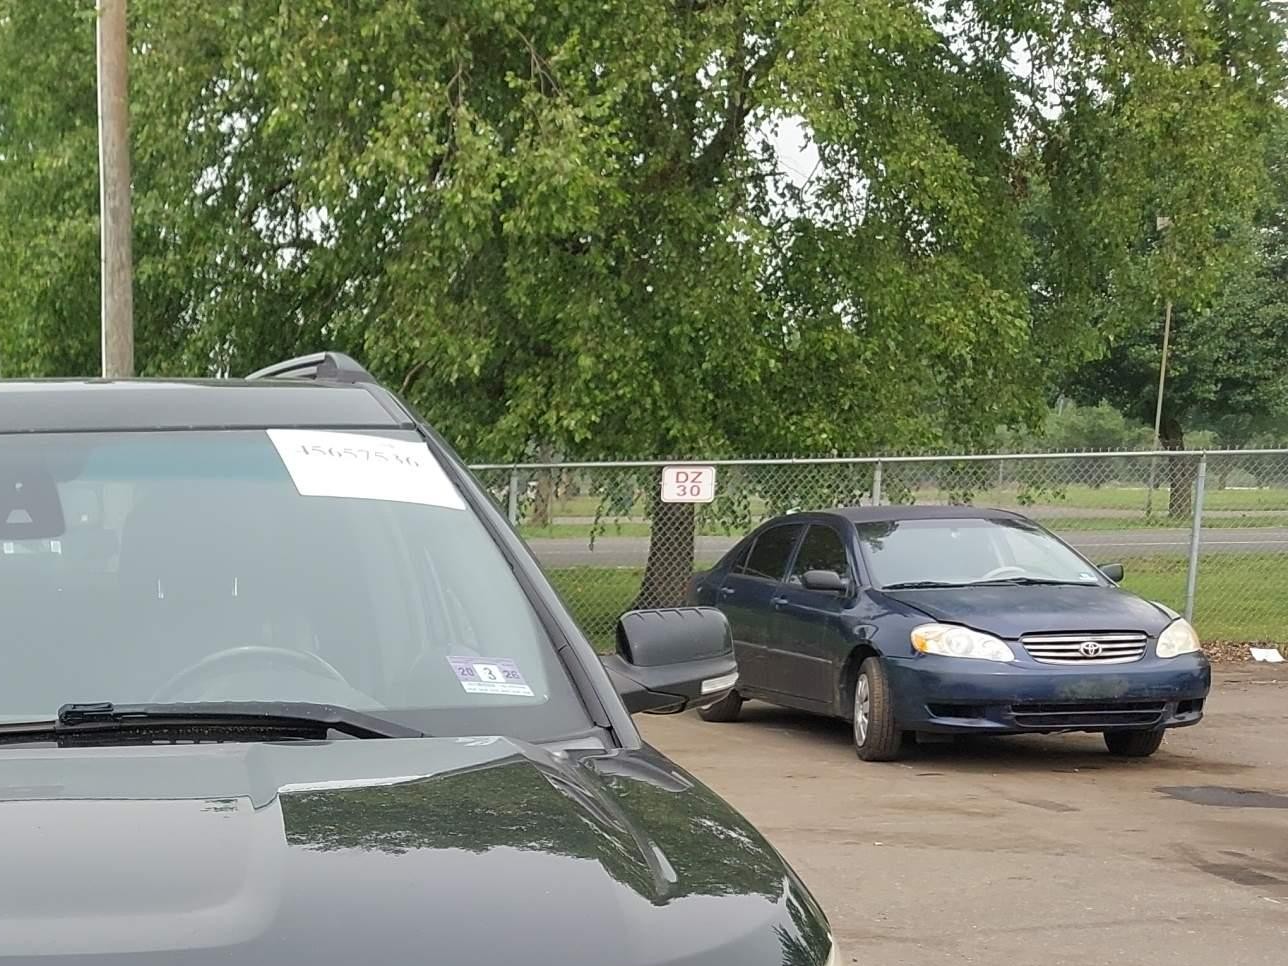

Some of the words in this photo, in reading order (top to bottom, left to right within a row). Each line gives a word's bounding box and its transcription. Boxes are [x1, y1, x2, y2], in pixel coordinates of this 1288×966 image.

[675, 471, 703, 484] DZ
[676, 484, 701, 497] 30
[482, 666, 497, 681] 3
